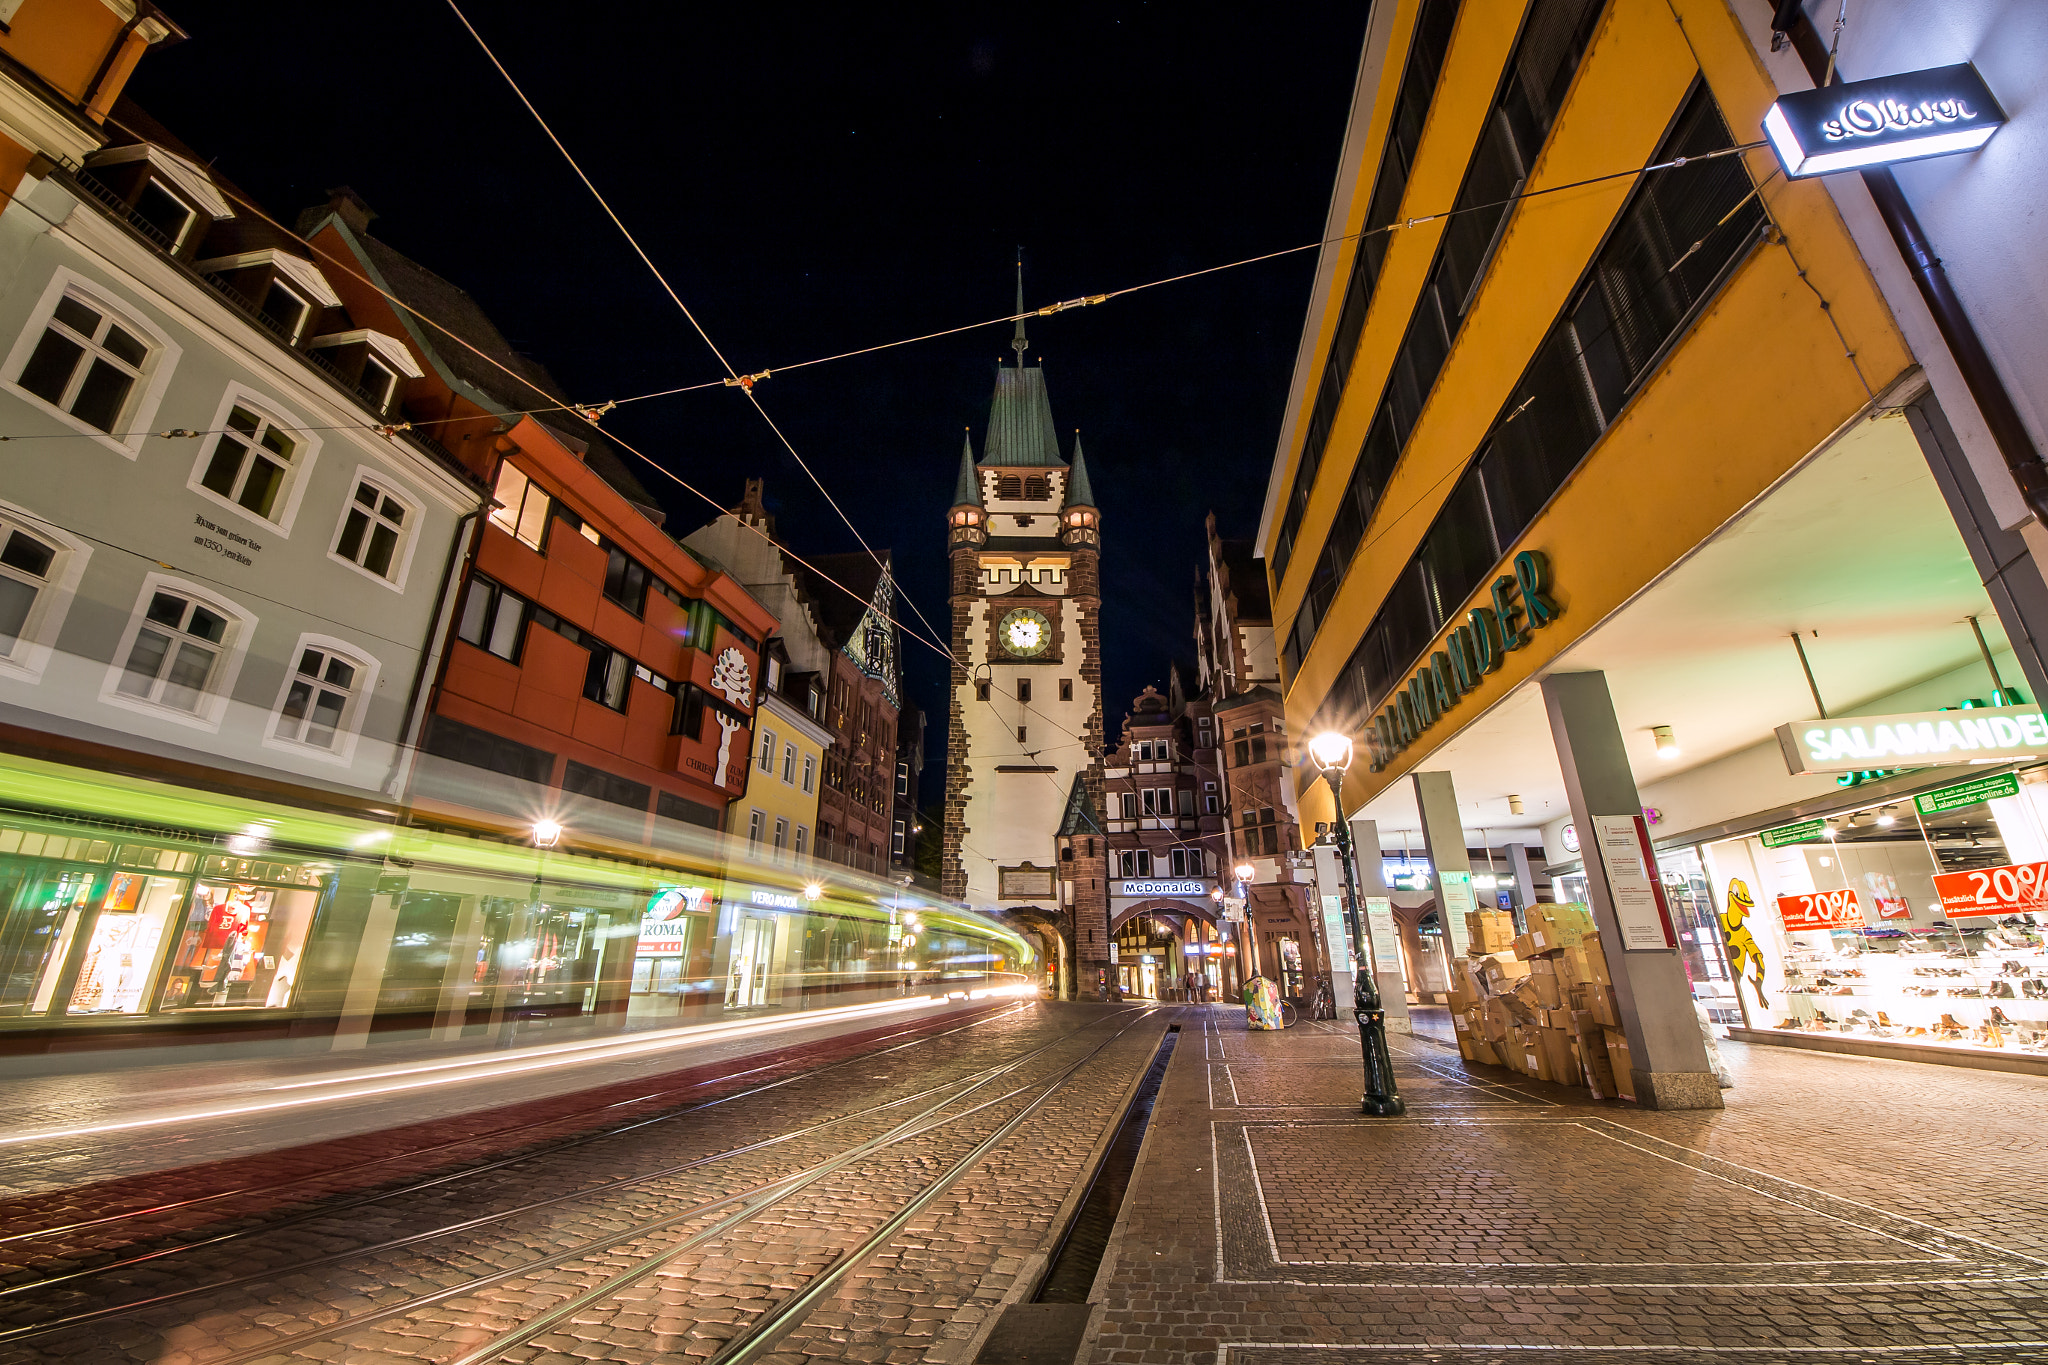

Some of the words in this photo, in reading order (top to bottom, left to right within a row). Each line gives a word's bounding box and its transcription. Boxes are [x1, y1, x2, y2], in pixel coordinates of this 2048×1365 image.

[1822, 99, 1978, 140] s.Oliver
[194, 513, 216, 531] Haus
[203, 538, 223, 552] 1350
[1363, 549, 1561, 774] SALAMANDER
[685, 757, 715, 776] CHRIESI
[729, 764, 744, 778] ZUM
[1984, 778, 2005, 787] shoppen
[1936, 786, 2015, 810] salamander-online.de
[1125, 882, 1201, 893] McDonald's
[751, 891, 774, 905] VERO
[774, 895, 798, 909] MODA
[1799, 891, 1860, 922] 20%
[1942, 894, 1976, 904] Zusätzlich
[644, 923, 684, 936] ROMA
